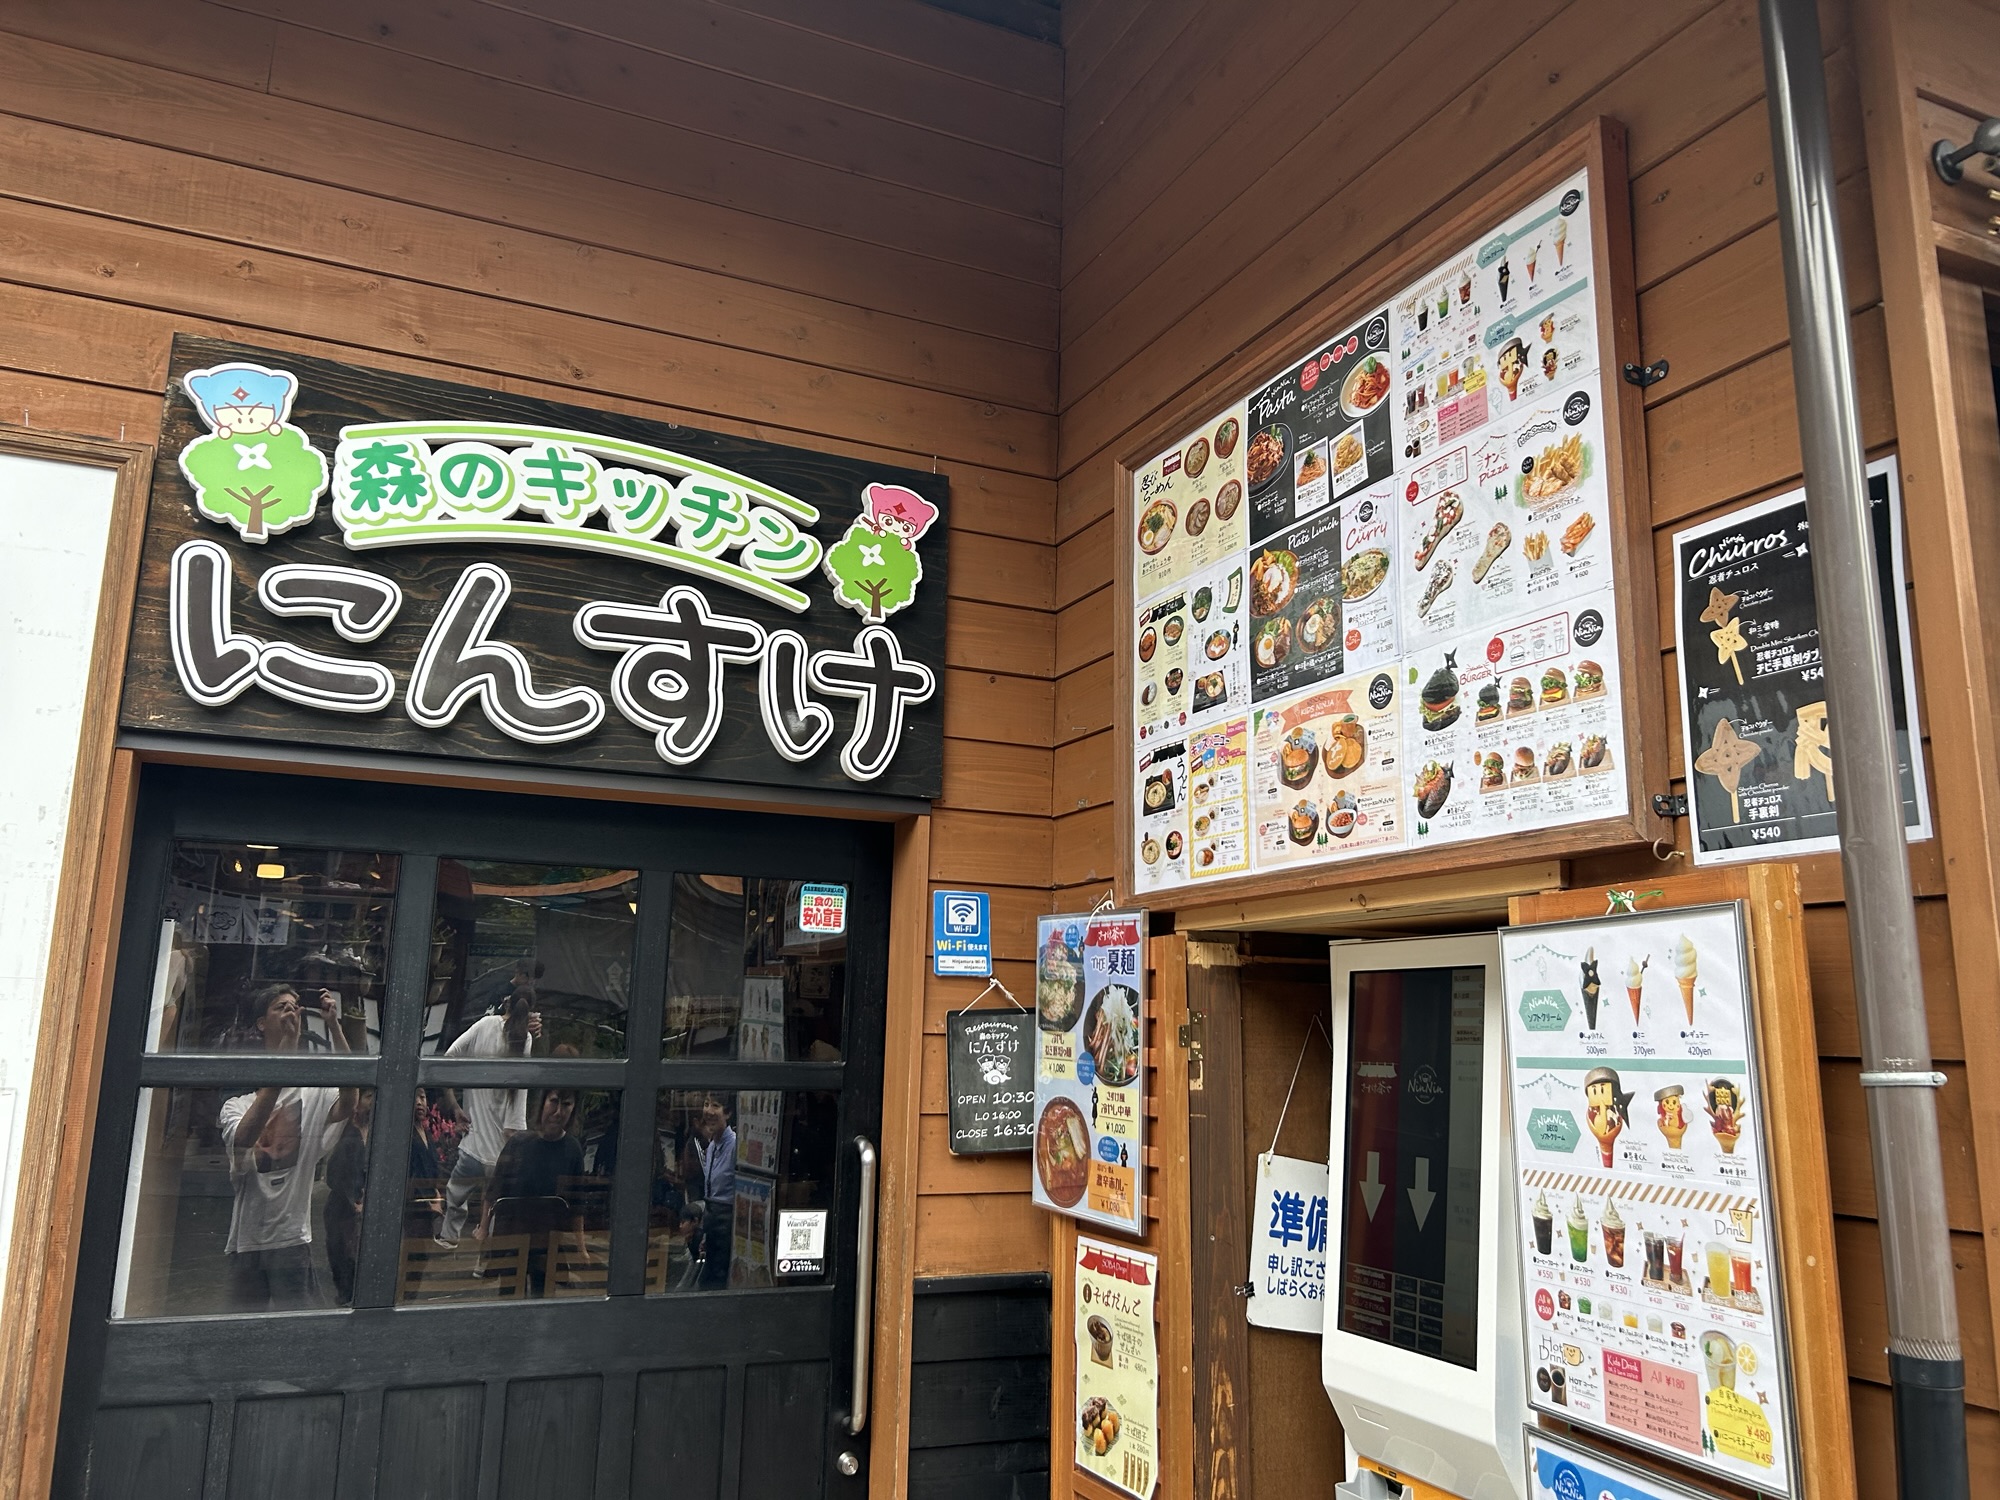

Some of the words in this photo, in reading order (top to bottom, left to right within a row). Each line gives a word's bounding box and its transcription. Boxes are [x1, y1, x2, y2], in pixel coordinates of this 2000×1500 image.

[1259, 389, 1297, 425] Pasta
[1484, 453, 1500, 468] ナン
[1143, 477, 1174, 506] らーめん
[346, 440, 816, 572] 森のキッチン
[1546, 512, 1561, 524] ¥720
[1288, 534, 1311, 551] Plate
[1311, 517, 1339, 539] Lunch
[1345, 521, 1388, 551] Curry
[1688, 530, 1788, 578] Churros
[1708, 562, 1759, 585] 忍者チュロス
[1574, 624, 1602, 638] NinNin
[1490, 651, 1501, 660] Set
[1756, 645, 1795, 661] 忍者チュロス
[172, 542, 934, 779] にんすけ
[1459, 670, 1492, 686] BURGER
[1801, 667, 1824, 681] ¥54
[1301, 705, 1314, 715] KIDS
[1315, 700, 1335, 711] NINJA
[1190, 734, 1230, 756] キッズメニュー
[1177, 757, 1187, 802] うどん
[1743, 794, 1782, 808] 忍者チュロス
[1748, 805, 1780, 820] 手裏剣
[1751, 826, 1781, 840] ¥540
[814, 896, 833, 907] 食の
[802, 907, 842, 928] 安心宣言
[937, 940, 967, 951] Wi-Fi
[1107, 948, 1136, 976] 夏麺
[1528, 995, 1560, 1011] NinNin
[1527, 1012, 1562, 1022] ソフトクリーム
[965, 1022, 1019, 1035] Restaurant
[1685, 1030, 1709, 1038] レギュラー
[969, 1040, 1020, 1053] にんすけ
[1586, 1046, 1607, 1056] 500yen
[1633, 1046, 1656, 1057] 370yen
[1687, 1046, 1712, 1057] 420yen
[1407, 1081, 1444, 1096] NinNin
[957, 1094, 986, 1104] OPEN
[992, 1091, 1034, 1104] 10:30
[992, 1110, 1021, 1120] 16:00
[1100, 1102, 1132, 1118] 冷やし中華
[1106, 1122, 1126, 1134] ¥1,020
[1537, 1114, 1568, 1129] NinNin
[1546, 1124, 1558, 1132] DECO
[956, 1129, 988, 1139] CLOSE
[1540, 1133, 1566, 1141] ソフトクリーム
[1628, 1163, 1643, 1171] ¥600
[1725, 1179, 1741, 1187] ¥600
[1714, 1219, 1745, 1237] Drink
[1537, 1269, 1553, 1279] ¥550
[1574, 1277, 1591, 1287] ¥530
[1610, 1284, 1628, 1295] ¥530
[1093, 1286, 1141, 1317] そばだんご
[1538, 1305, 1552, 1315] ¥300
[1542, 1334, 1563, 1352] Hot
[1539, 1344, 1567, 1365] Drink
[1607, 1354, 1620, 1366] Kids
[1621, 1359, 1639, 1372] Drink
[1569, 1376, 1582, 1386] HOT
[1651, 1370, 1662, 1383] All
[1665, 1375, 1685, 1390] ¥180
[1574, 1400, 1591, 1409] ¥420
[1747, 1425, 1771, 1443] ¥480
[1754, 1450, 1775, 1465] ¥450
